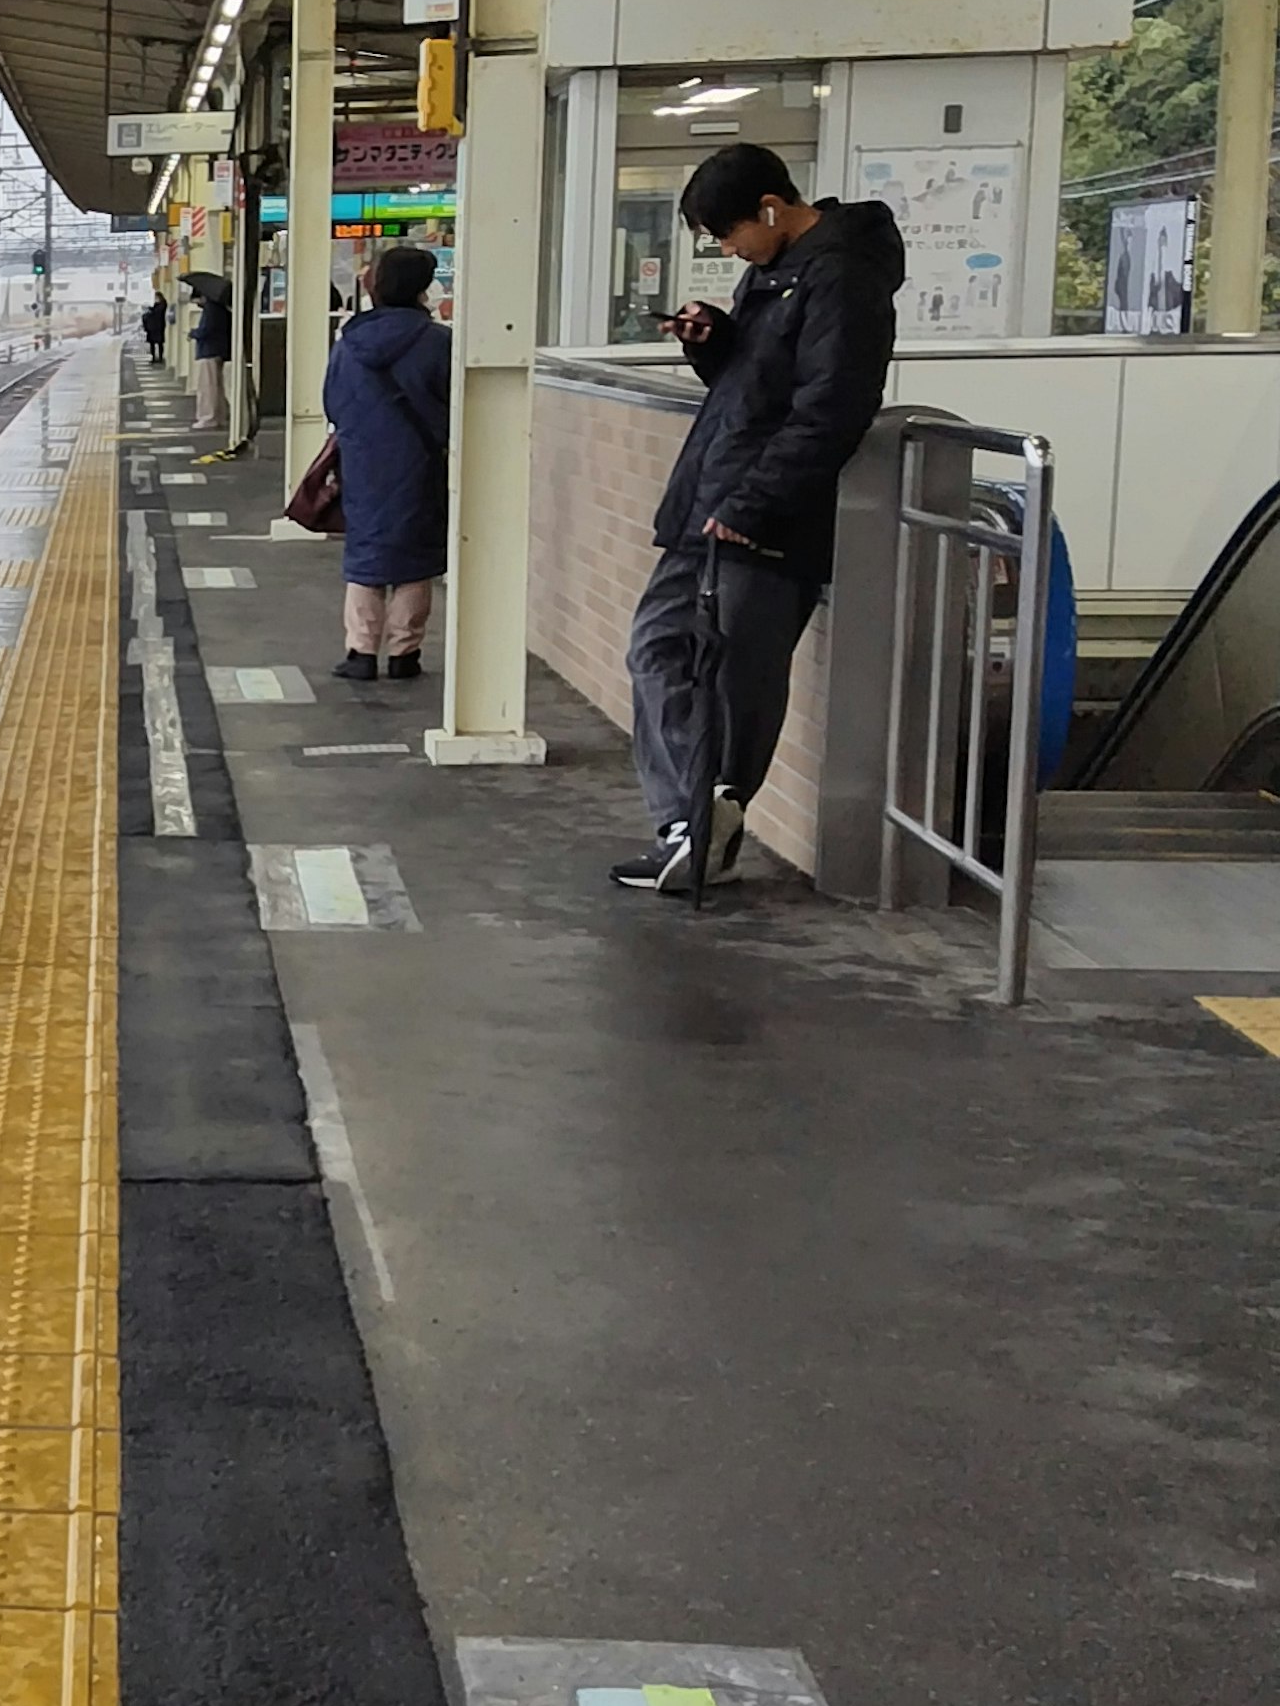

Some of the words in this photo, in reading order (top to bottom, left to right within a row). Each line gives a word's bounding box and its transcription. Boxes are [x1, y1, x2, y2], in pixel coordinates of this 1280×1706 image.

[145, 121, 217, 134] エレベーター
